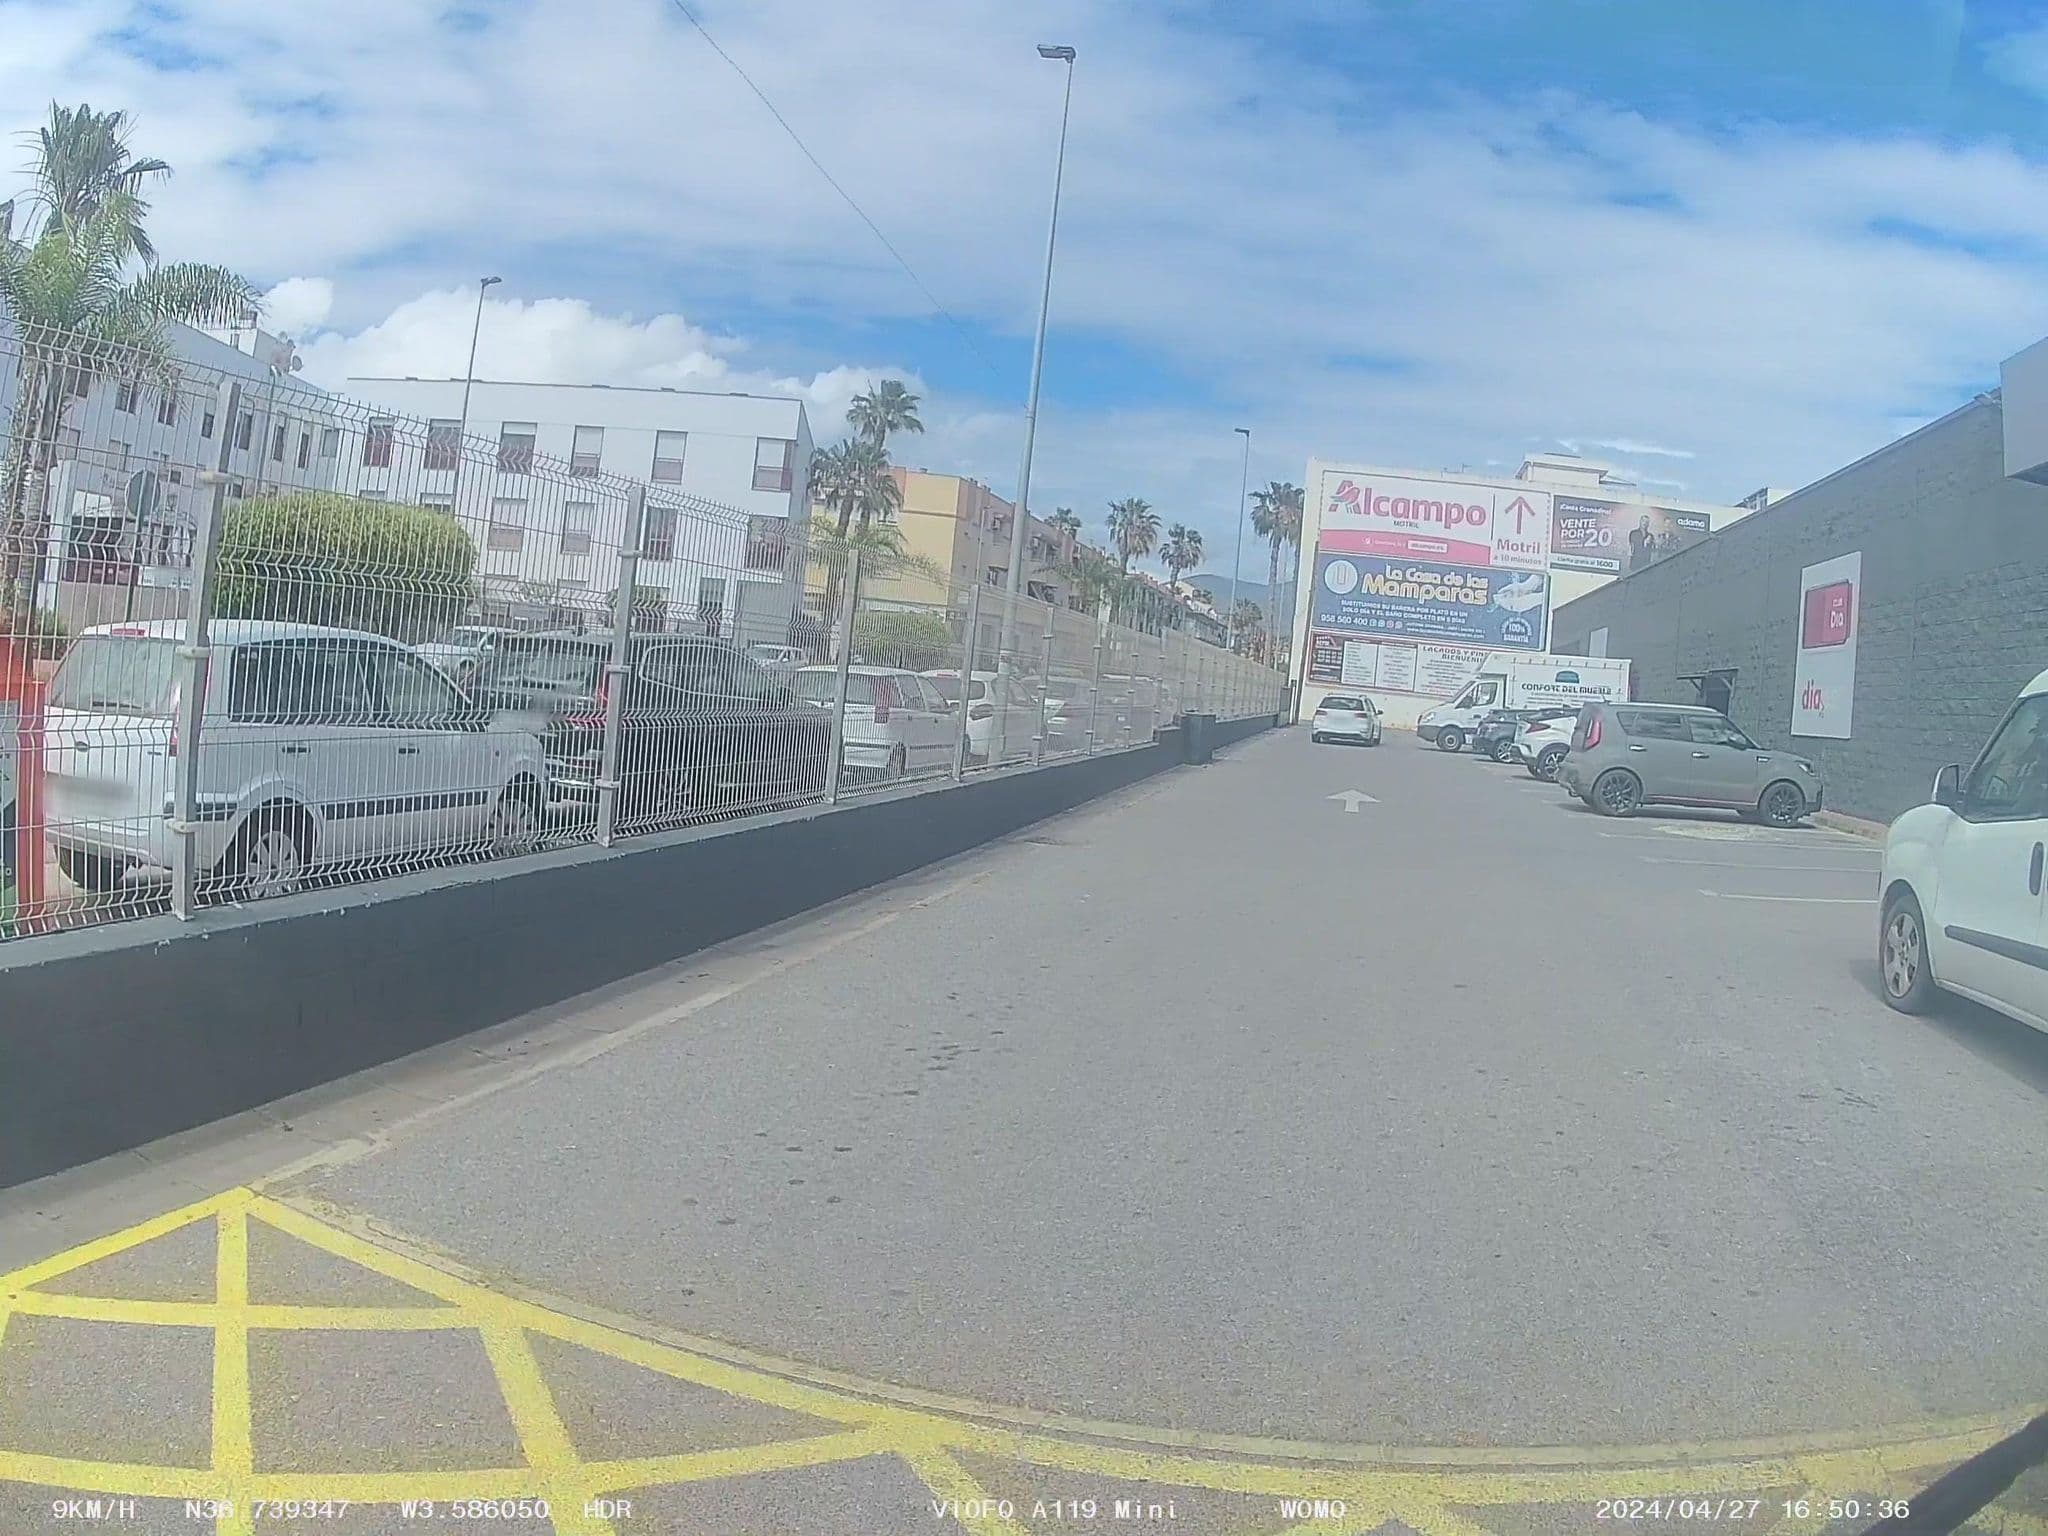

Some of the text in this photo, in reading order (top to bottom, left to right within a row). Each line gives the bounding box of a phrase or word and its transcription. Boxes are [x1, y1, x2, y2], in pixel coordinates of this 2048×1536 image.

[1328, 480, 1487, 529] Alcampo
[1393, 520, 1419, 529] MOTRIL
[1560, 518, 1596, 528] VENTE
[1677, 518, 1705, 528] adamo
[1561, 529, 1584, 539] POR
[1584, 528, 1612, 547] 20
[1497, 539, 1541, 554] Motril
[1511, 555, 1542, 565] minutos
[1385, 565, 1488, 588] La Casa de las
[1361, 573, 1488, 605] Mamparas
[1353, 617, 1368, 626] 400
[1562, 684, 1578, 694] DEL
